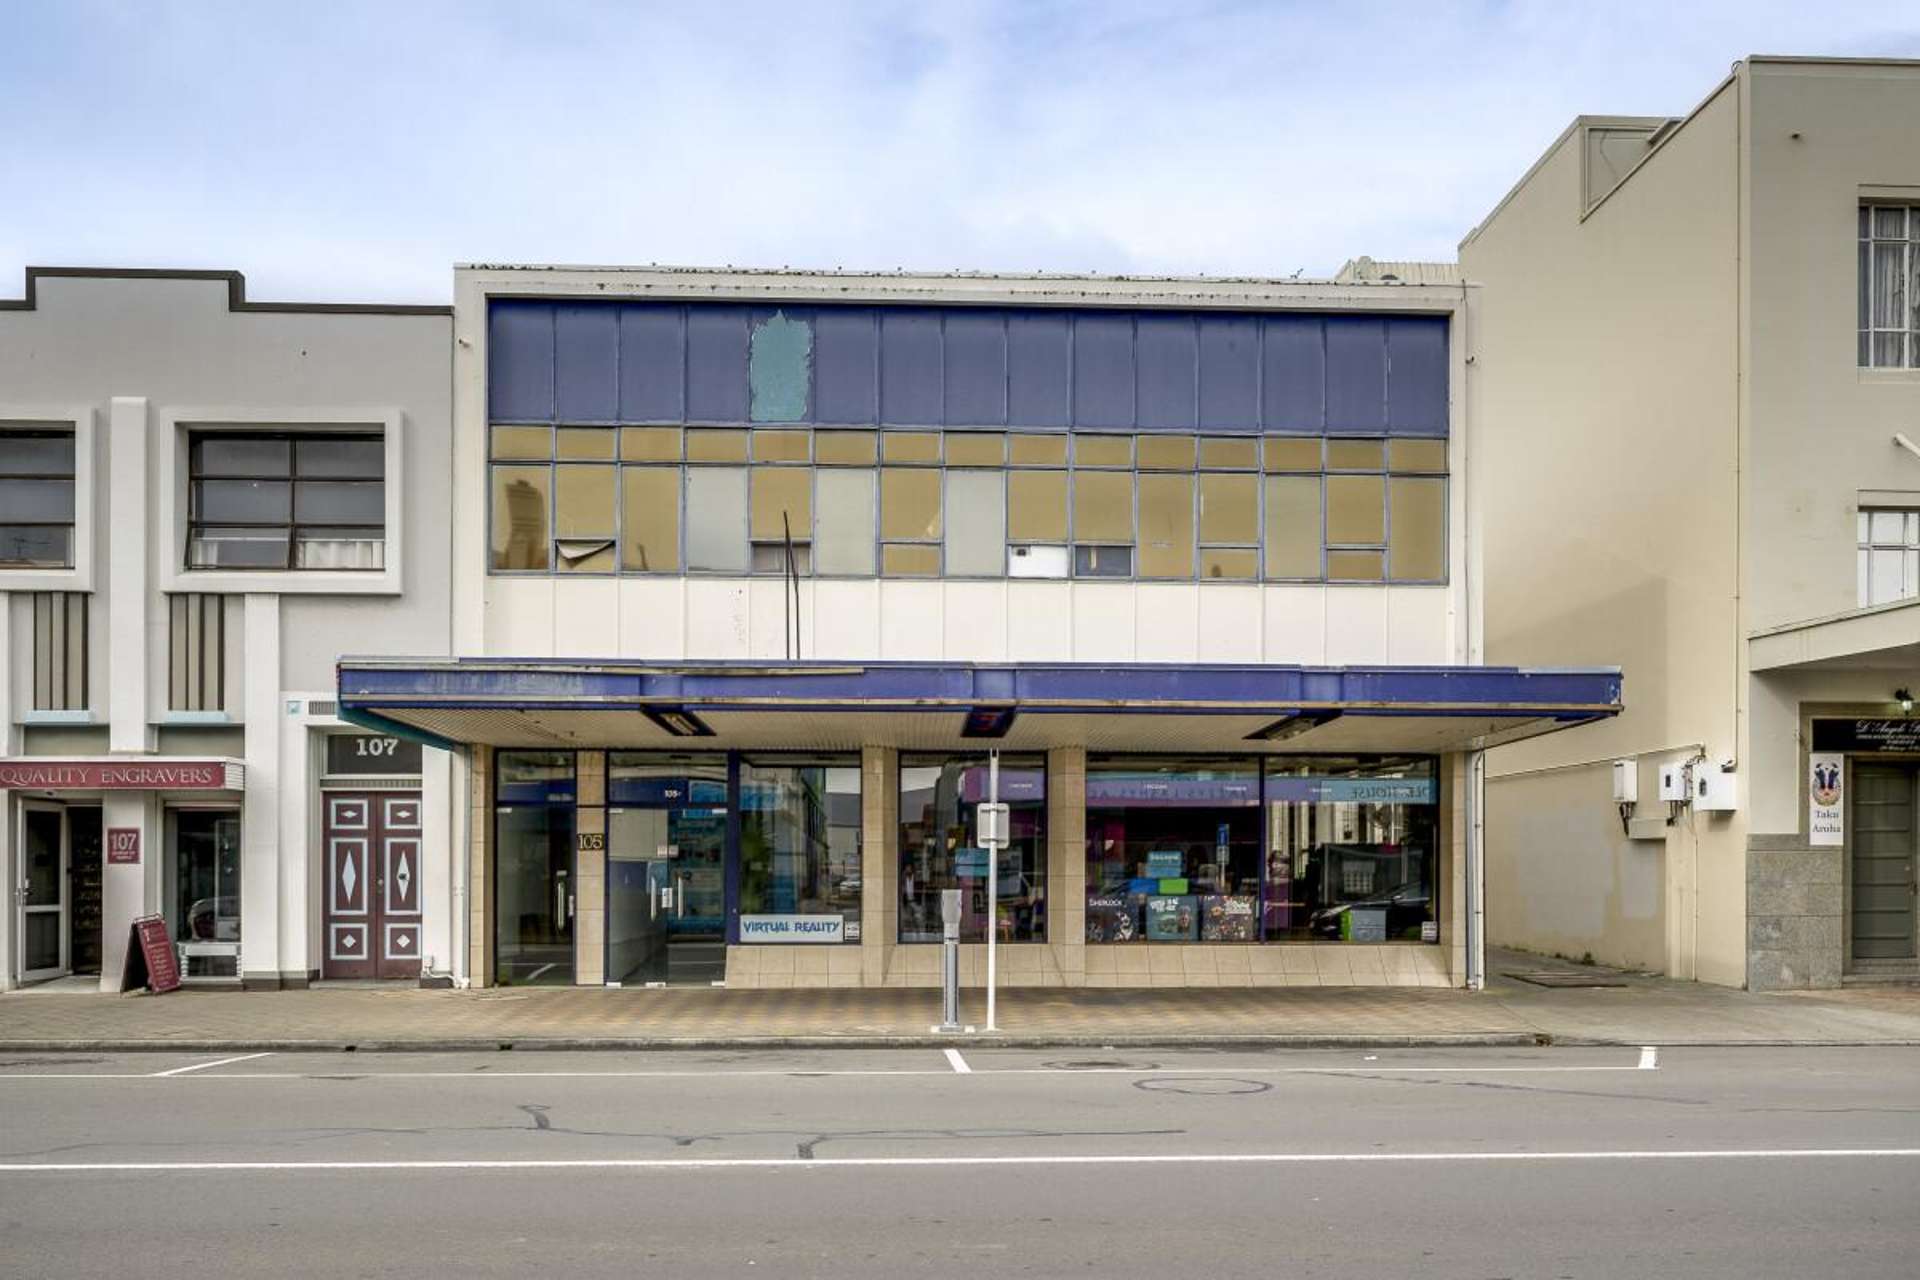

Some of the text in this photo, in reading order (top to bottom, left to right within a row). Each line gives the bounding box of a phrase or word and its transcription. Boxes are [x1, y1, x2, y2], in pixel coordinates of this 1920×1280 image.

[356, 738, 399, 756] 107
[0, 767, 213, 786] QUALITY ENGRAVERS
[111, 833, 137, 850] 107
[578, 834, 603, 849] 105
[743, 920, 790, 934] VIRTUAL
[794, 920, 840, 933] REALITY
